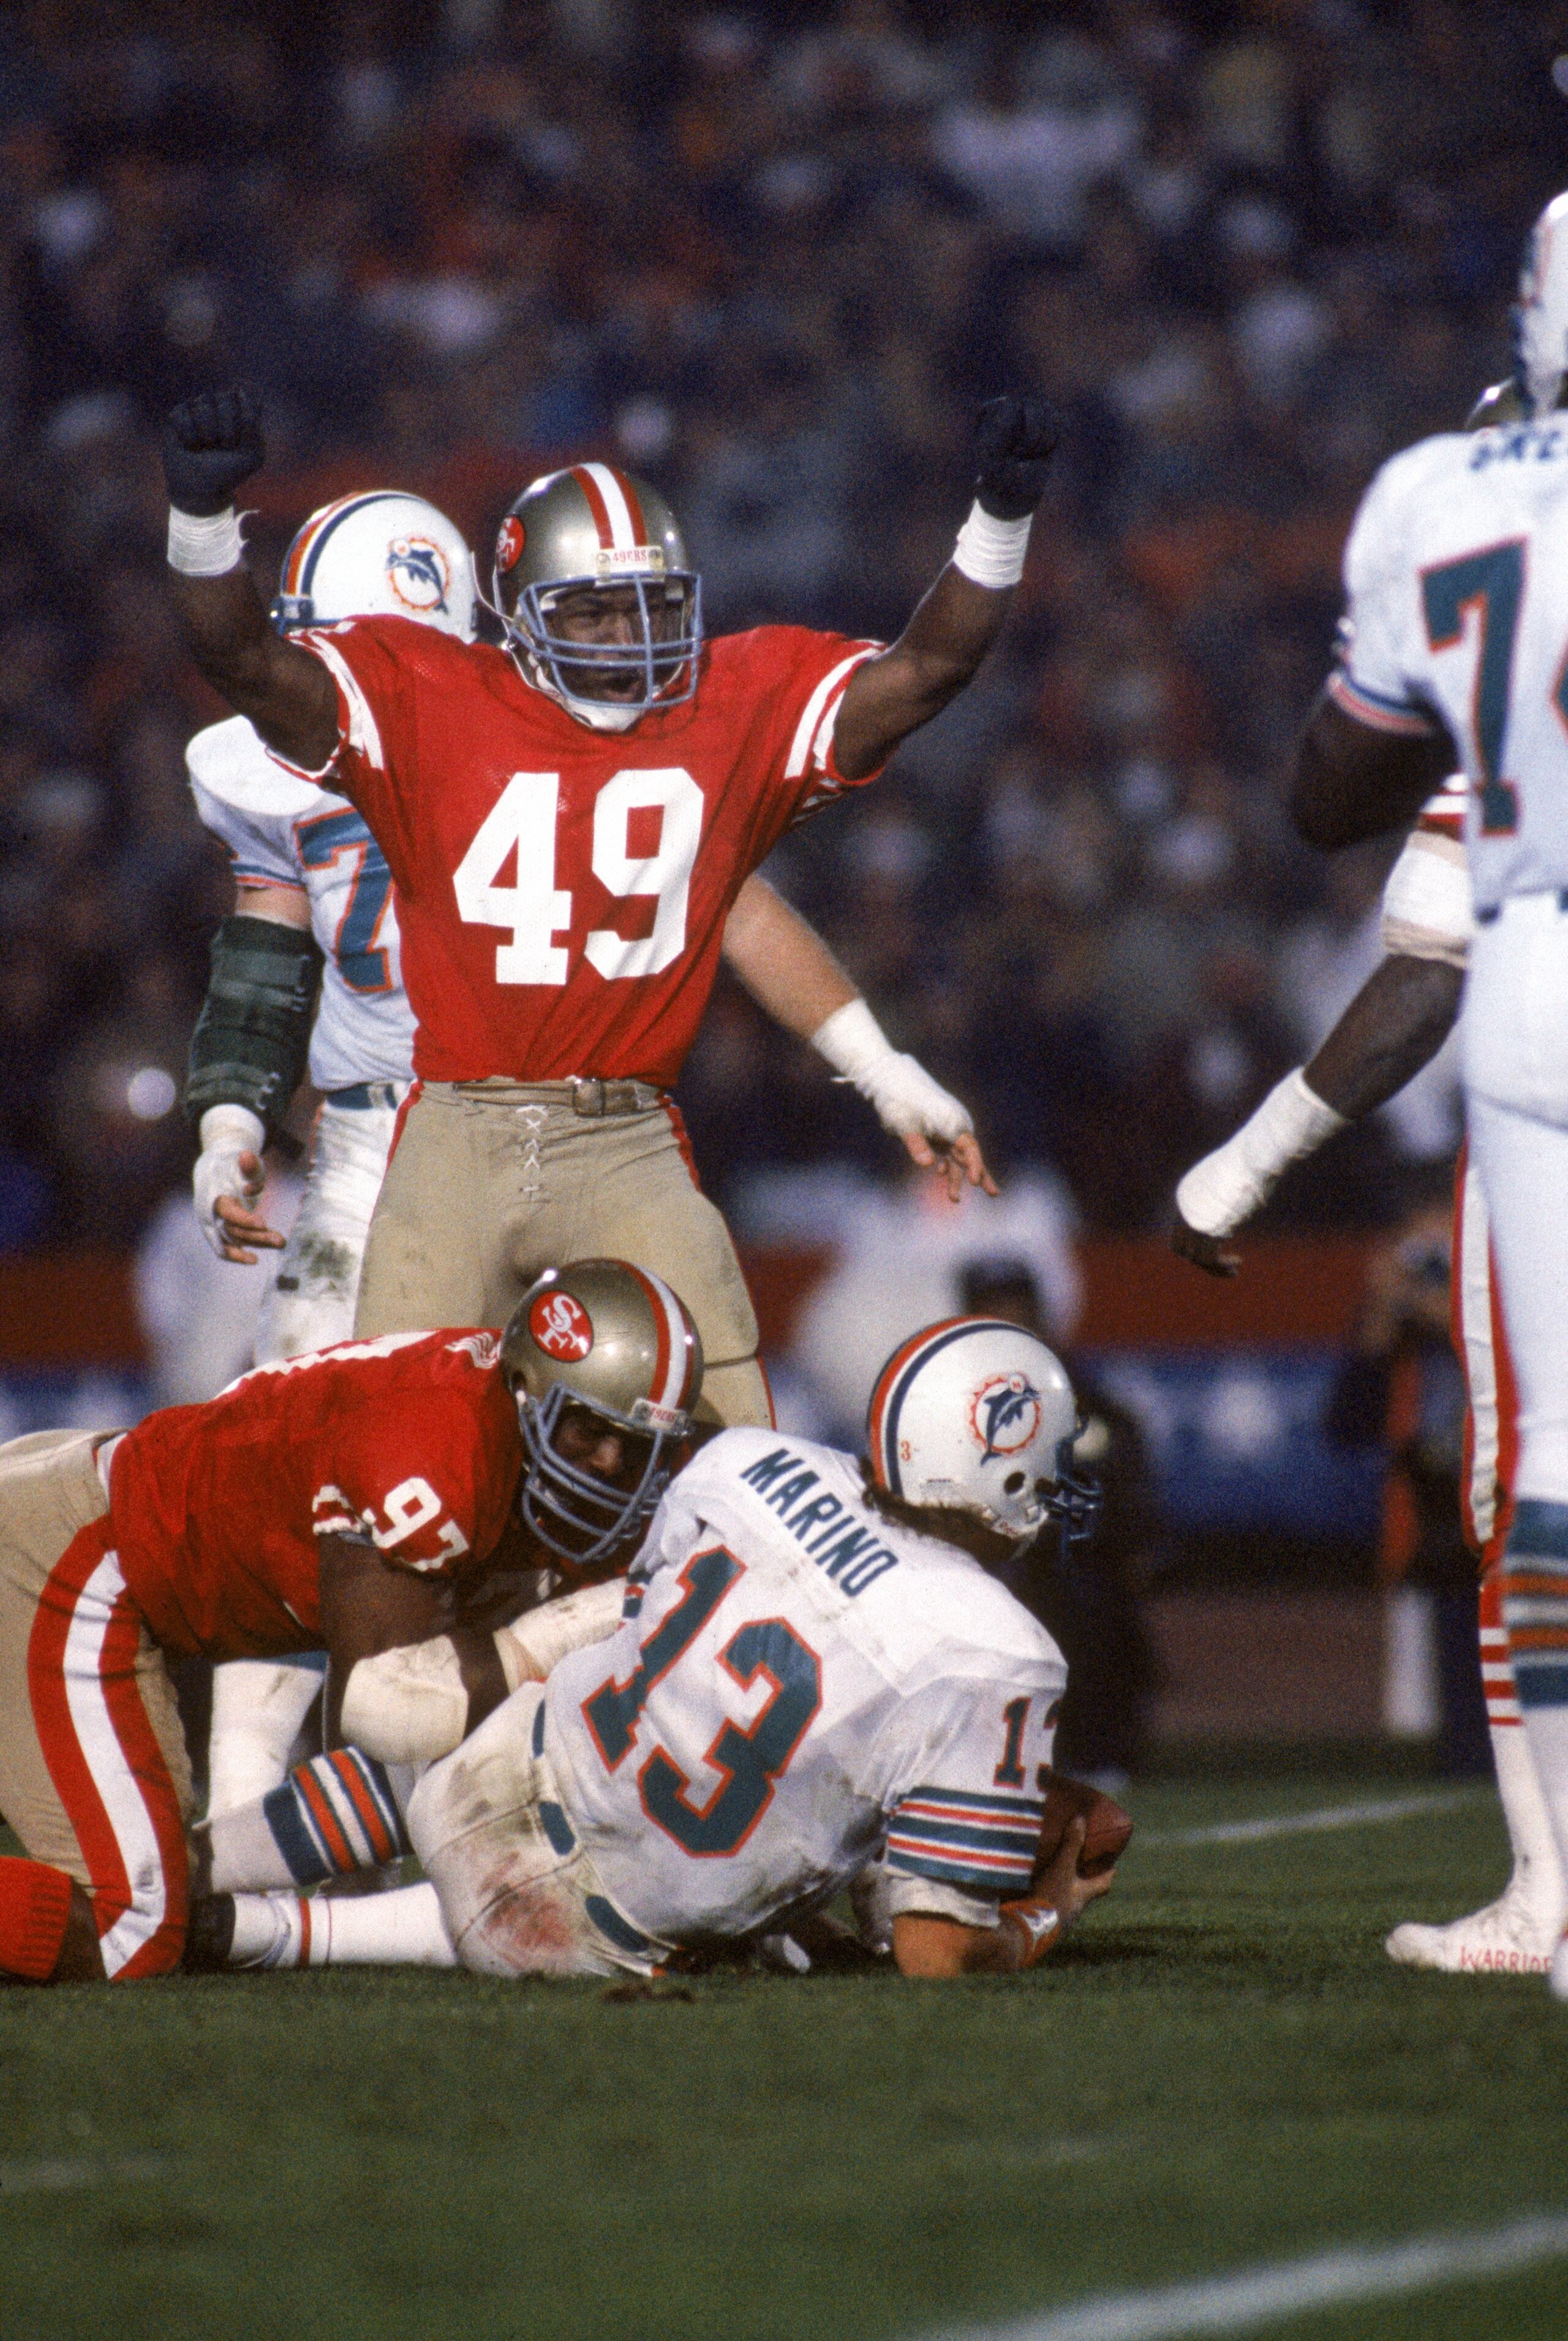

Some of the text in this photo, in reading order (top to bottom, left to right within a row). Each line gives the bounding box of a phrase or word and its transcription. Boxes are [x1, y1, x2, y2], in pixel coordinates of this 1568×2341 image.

[1419, 533, 1568, 838] 7
[453, 768, 704, 985] 49
[740, 1448, 899, 1598] MARINO
[581, 1544, 823, 1859] 13
